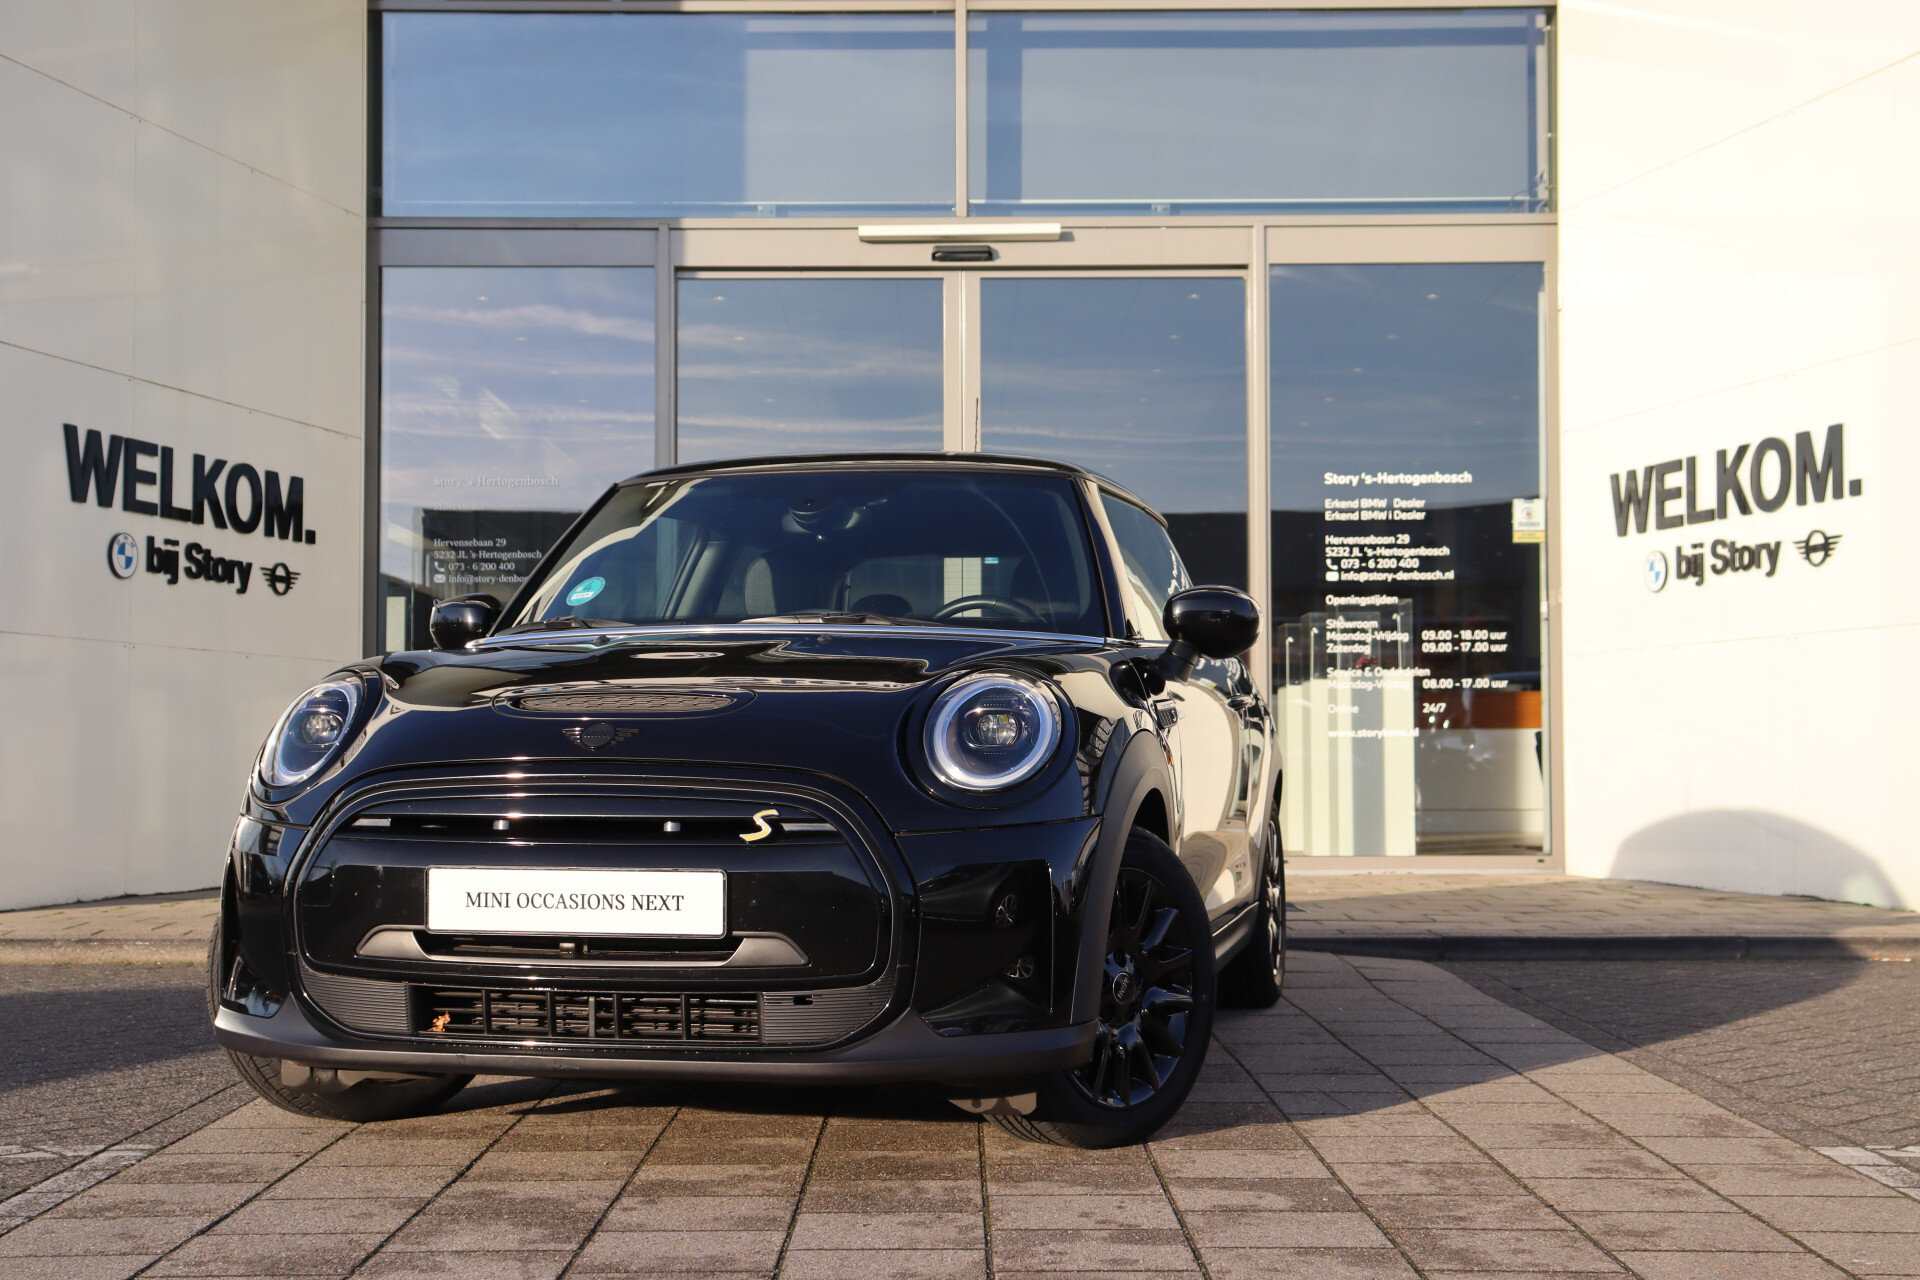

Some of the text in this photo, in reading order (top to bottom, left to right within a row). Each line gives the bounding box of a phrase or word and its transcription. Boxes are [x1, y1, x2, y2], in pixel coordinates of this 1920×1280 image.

[63, 423, 316, 545] WELKOM.
[1323, 471, 1473, 487] Story 's-Hertogenbosch
[1610, 423, 1862, 537] WELKOM.
[1324, 497, 1426, 509] Erkend BMW Dealer
[1325, 510, 1359, 521] Erkend
[1360, 510, 1388, 521] BMW
[1393, 509, 1426, 520] Dealer
[433, 538, 506, 547] Hervensebaan 29
[1325, 533, 1410, 545] Hervensebaan 29
[433, 550, 542, 560] 5232 JL 's-Hertogenbosch
[1325, 546, 1450, 558] 5232 JL 's-Hertogenbosch
[146, 535, 253, 595] bij Story
[448, 562, 465, 571] 073
[472, 562, 478, 571] 6
[480, 562, 497, 571] 200
[498, 562, 515, 571] 400
[1340, 558, 1360, 568] 073
[1367, 558, 1375, 568] 6
[1376, 558, 1397, 568] 200
[1398, 558, 1419, 568] 400
[1675, 538, 1782, 587] bij Story
[1340, 569, 1455, 582] info@story-denbosch.nl
[1325, 594, 1399, 606] Openingstijden
[1326, 618, 1378, 629] Showroom
[1326, 630, 1409, 642] Maandag-Vrijdag
[1421, 630, 1452, 641] 09.00
[1459, 629, 1488, 640] 18.00
[1489, 631, 1507, 640] uur
[1326, 642, 1371, 654] Zaterdag
[1421, 642, 1452, 652] 09.00
[1490, 643, 1507, 652] uur
[1326, 666, 1362, 677] Service
[1363, 666, 1373, 677] &
[1422, 679, 1453, 689] 08.00
[1491, 679, 1509, 689] uur
[1422, 703, 1446, 713] 24/7
[739, 808, 780, 842] S
[465, 891, 685, 912] MINI OCCASIONS NEXT
